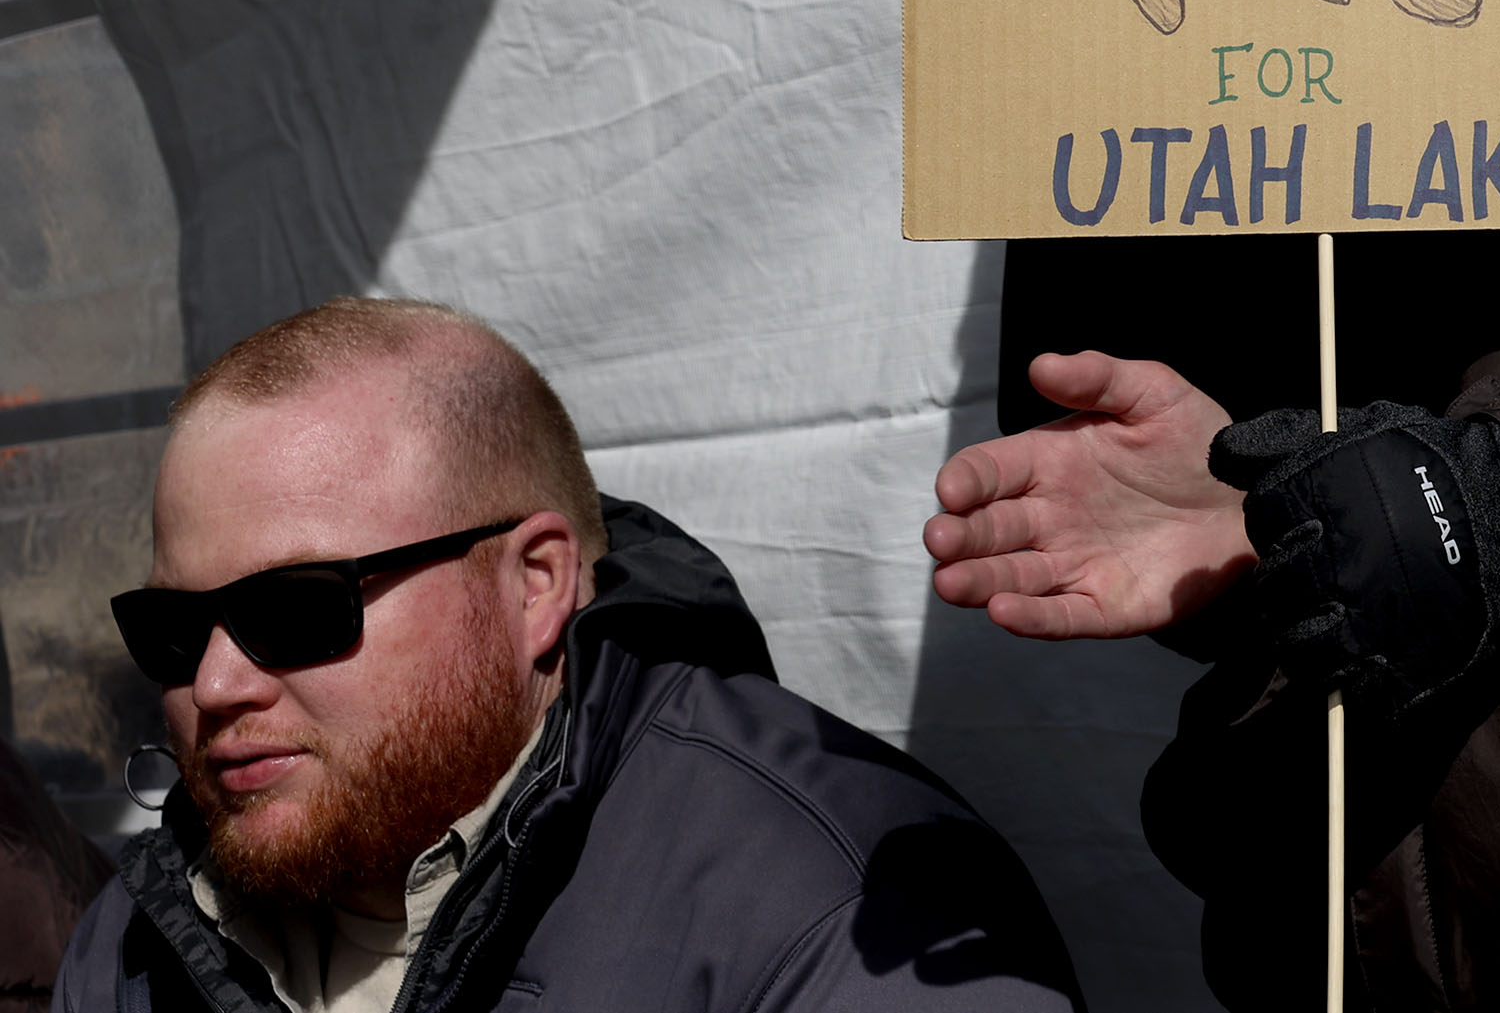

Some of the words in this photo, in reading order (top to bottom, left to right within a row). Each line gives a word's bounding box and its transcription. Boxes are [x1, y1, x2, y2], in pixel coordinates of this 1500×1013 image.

[1208, 43, 1343, 106] FOR
[1052, 123, 1307, 227] UTAH
[1413, 465, 1461, 566] HEAD
